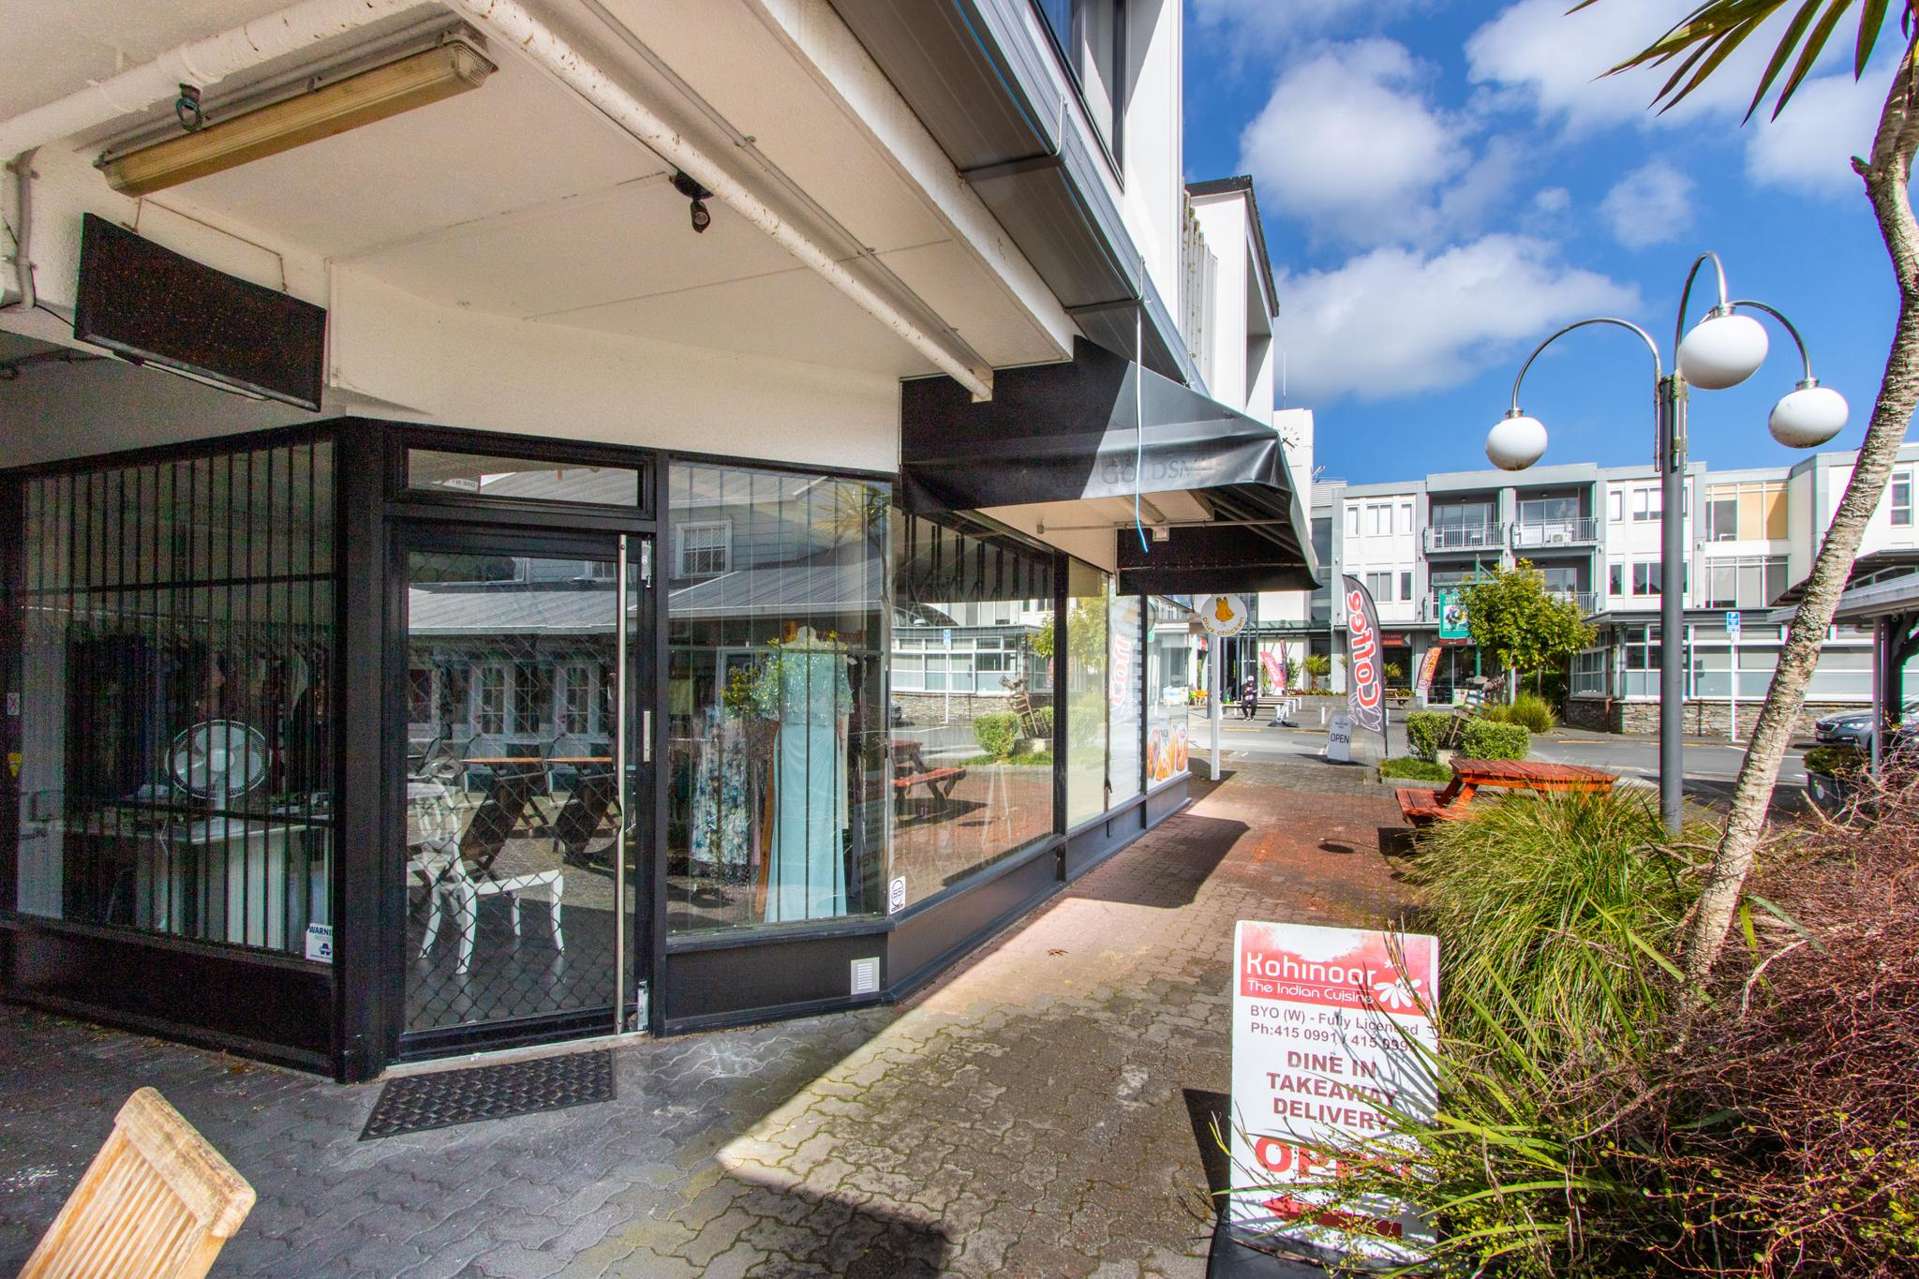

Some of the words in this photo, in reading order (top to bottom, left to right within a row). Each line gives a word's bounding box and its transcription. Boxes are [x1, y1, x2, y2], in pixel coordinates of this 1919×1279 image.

[1330, 732, 1350, 744] OPEN
[1246, 951, 1376, 986] Kohinoor
[1248, 979, 1273, 993] The
[1277, 982, 1320, 998] Indian
[1324, 988, 1375, 1005] Cuisine
[1250, 1004, 1280, 1019] BYO
[1283, 1009, 1306, 1025] (W)
[1318, 1012, 1351, 1031] Fully
[1356, 1015, 1419, 1036] Licened
[1250, 1022, 1299, 1039] Ph:415
[1303, 1028, 1337, 1043] 0991
[1350, 1034, 1378, 1049] 415
[1382, 1037, 1413, 1052] 099
[1287, 1050, 1343, 1075] DINE
[1352, 1059, 1377, 1078] IN
[1266, 1071, 1398, 1108] TAKEAWAY
[1273, 1096, 1389, 1132] DELIVERY
